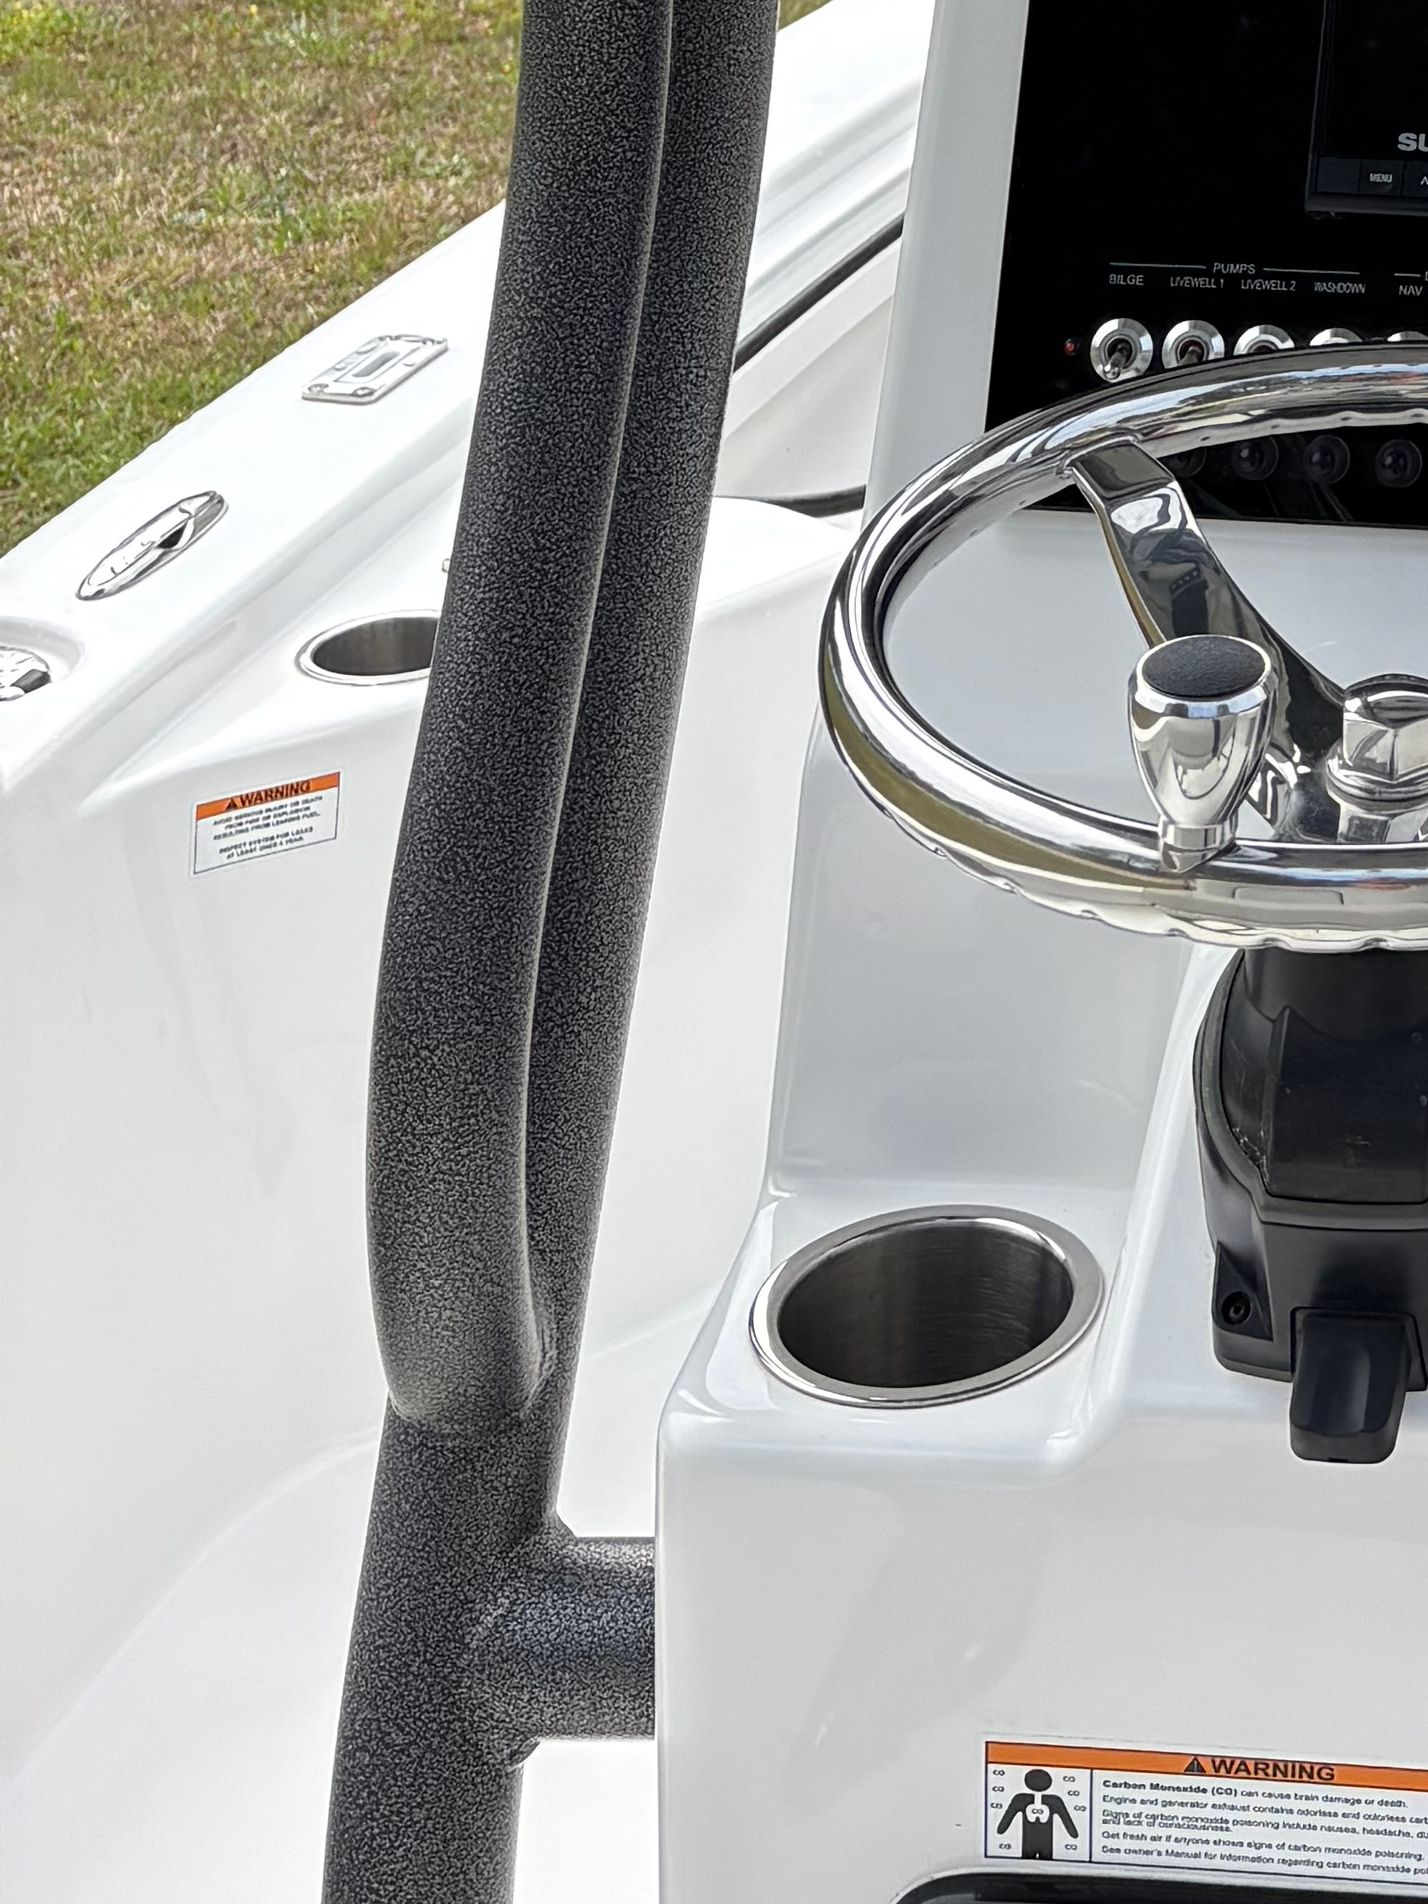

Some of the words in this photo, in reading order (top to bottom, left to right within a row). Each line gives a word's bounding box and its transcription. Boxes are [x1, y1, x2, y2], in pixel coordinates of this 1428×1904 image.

[1370, 172, 1392, 183] MENU
[1213, 262, 1256, 275] PUMPS
[1108, 274, 1144, 286] BILGE
[1170, 276, 1216, 288] LIVEWELL
[1219, 278, 1224, 288] 1
[1241, 278, 1286, 290] LIVEWELL
[1288, 280, 1296, 292] 2
[1314, 282, 1366, 294] WASHDOWN
[1398, 284, 1423, 296] NAV
[240, 780, 310, 806] WARNING
[1211, 1758, 1335, 1781] WARNING
[1102, 1779, 1146, 1789] Carbon
[1150, 1782, 1208, 1793] Monoxide
[1211, 1786, 1238, 1795] (CO)
[1261, 1791, 1290, 1799] cause
[1294, 1792, 1319, 1801] brain
[1321, 1794, 1362, 1805] damage
[1376, 1797, 1408, 1807] death.
[1102, 1794, 1136, 1806] Engine
[1139, 1797, 1158, 1805] and
[1161, 1798, 1208, 1810] generator
[1210, 1802, 1250, 1812] exhaust
[1252, 1805, 1294, 1815] contains
[1341, 1810, 1360, 1819] and
